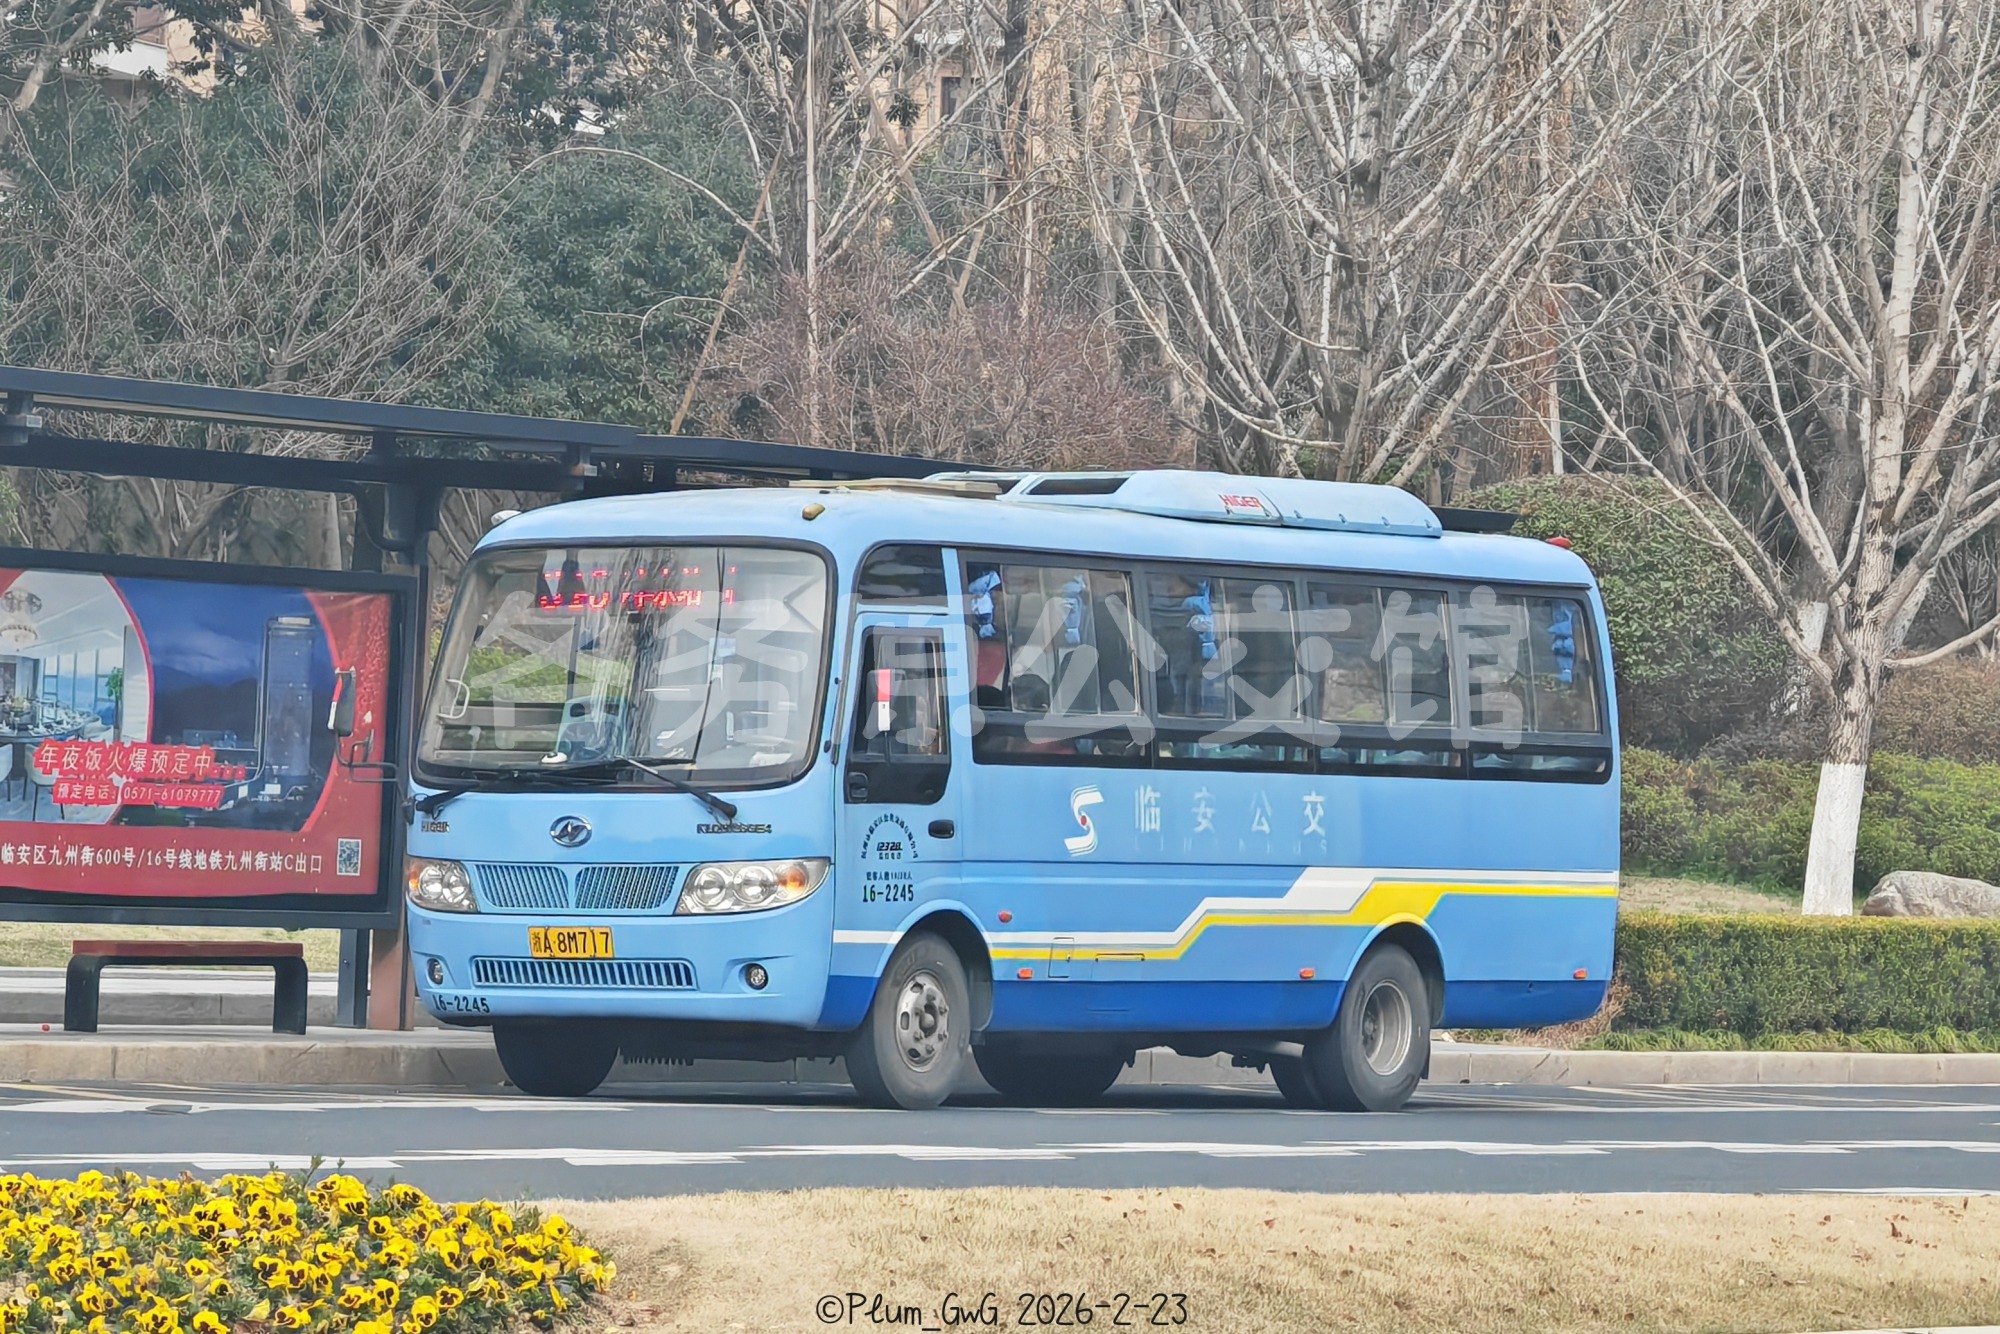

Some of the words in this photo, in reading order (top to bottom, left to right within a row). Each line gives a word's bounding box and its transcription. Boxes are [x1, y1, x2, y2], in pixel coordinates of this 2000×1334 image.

[1134, 785, 1326, 838] 临安公交
[1, 842, 322, 873] 临安区九州街600号/16号线地铁九州街站C出口
[862, 884, 914, 903] 16-2245
[432, 994, 490, 1013] 16-2245
